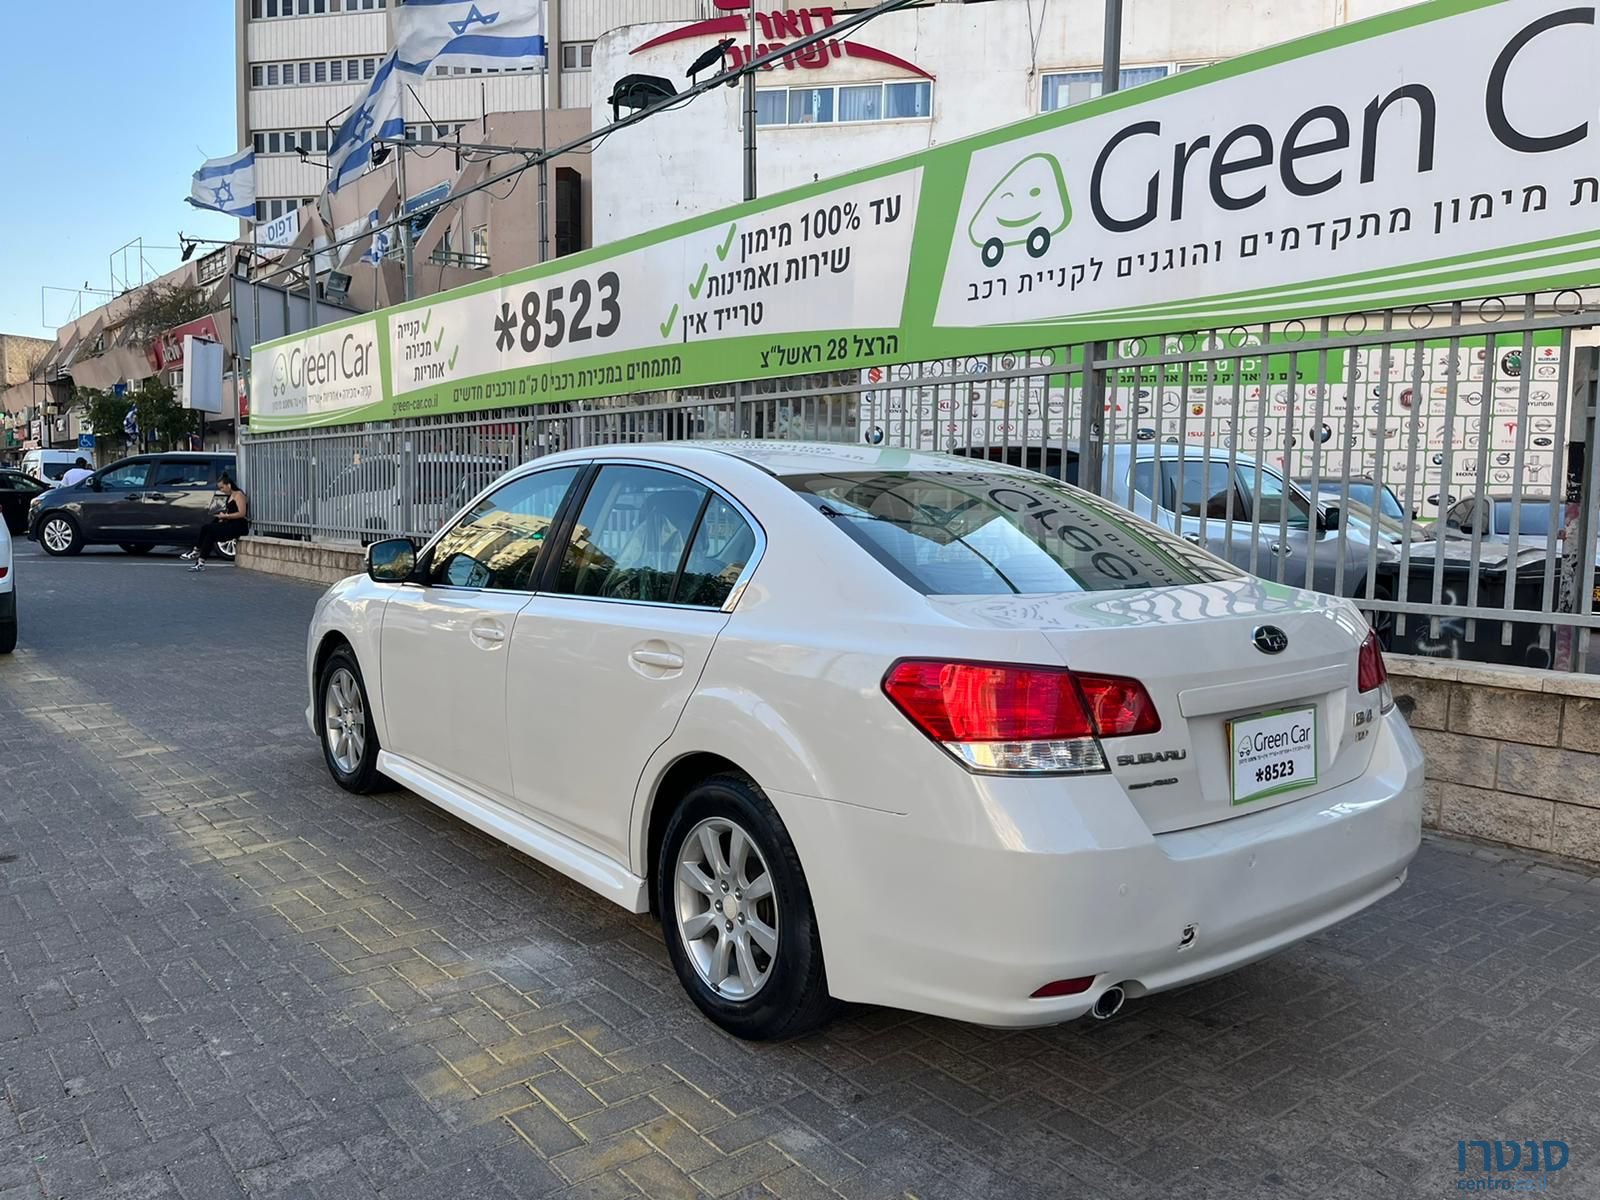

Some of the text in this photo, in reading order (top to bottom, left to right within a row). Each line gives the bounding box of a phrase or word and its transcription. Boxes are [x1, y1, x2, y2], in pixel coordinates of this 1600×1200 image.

[748, 7, 834, 40] דואר
[1089, 83, 1436, 233] Green
[1432, 184, 1547, 234] מימון
[267, 215, 293, 241] דפוס
[740, 194, 902, 263] עד 100% מימון
[1239, 206, 1411, 258] מתקדמים
[1117, 240, 1222, 278] והוגנים
[706, 246, 851, 299] שירות ואמינות
[1017, 256, 1104, 294] לקניית
[967, 277, 1007, 302] רכב
[397, 319, 420, 340] קנייה
[682, 301, 764, 343] טרייד אין
[405, 340, 432, 360] מכירה
[826, 337, 848, 362] 28
[852, 334, 899, 357] הרצל
[290, 333, 373, 389] Green Car
[413, 361, 445, 382] אחריות
[626, 356, 681, 384] מתמחים
[485, 379, 516, 399] ורכבים
[577, 365, 623, 389] במכירת
[1279, 371, 1303, 381] לם
[392, 393, 439, 416] green-car.co.il
[453, 384, 483, 403] חדשים
[1254, 724, 1311, 752] Green Car
[1117, 749, 1187, 766] SUBARU
